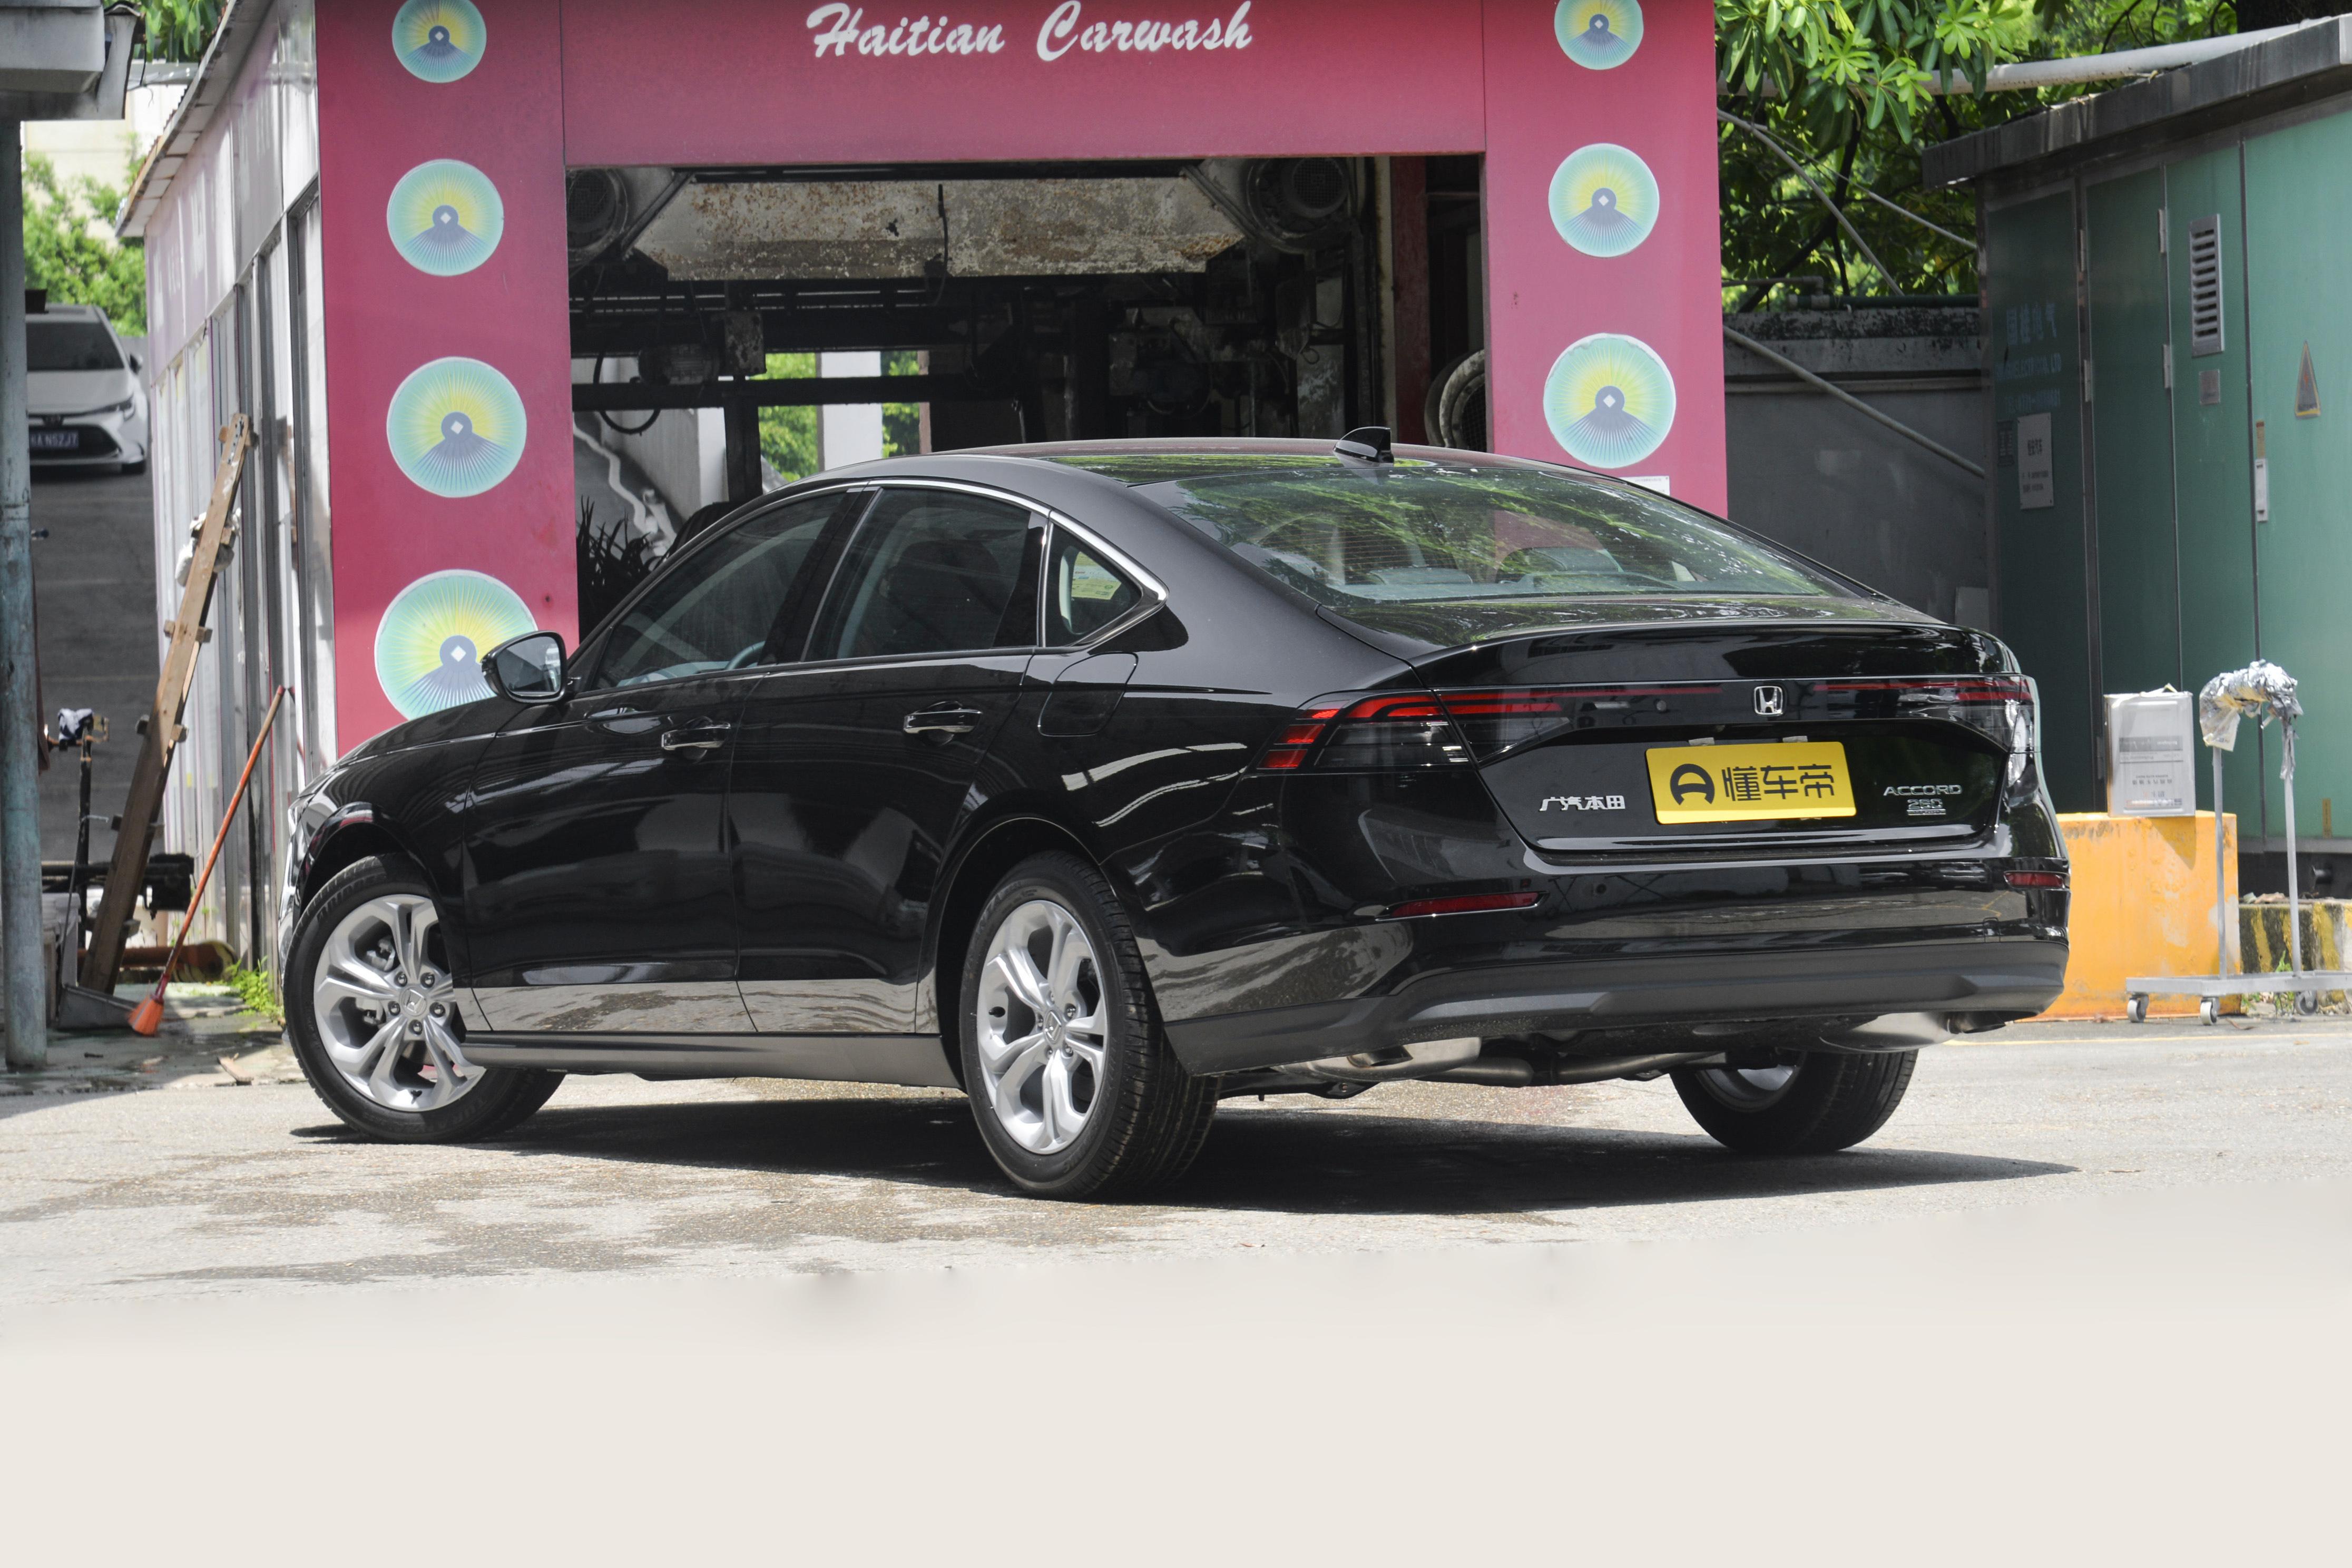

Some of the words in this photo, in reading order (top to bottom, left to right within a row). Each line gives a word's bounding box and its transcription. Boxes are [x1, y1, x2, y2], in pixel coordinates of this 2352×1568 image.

[806, 2, 1005, 57] Haitian
[1036, 0, 1253, 62] Carwash
[1721, 763, 1835, 802] 懂车帝
[1883, 785, 1963, 797] ACCORD
[1539, 795, 1626, 811] 广汽本田
[1907, 798, 1943, 809] 260
